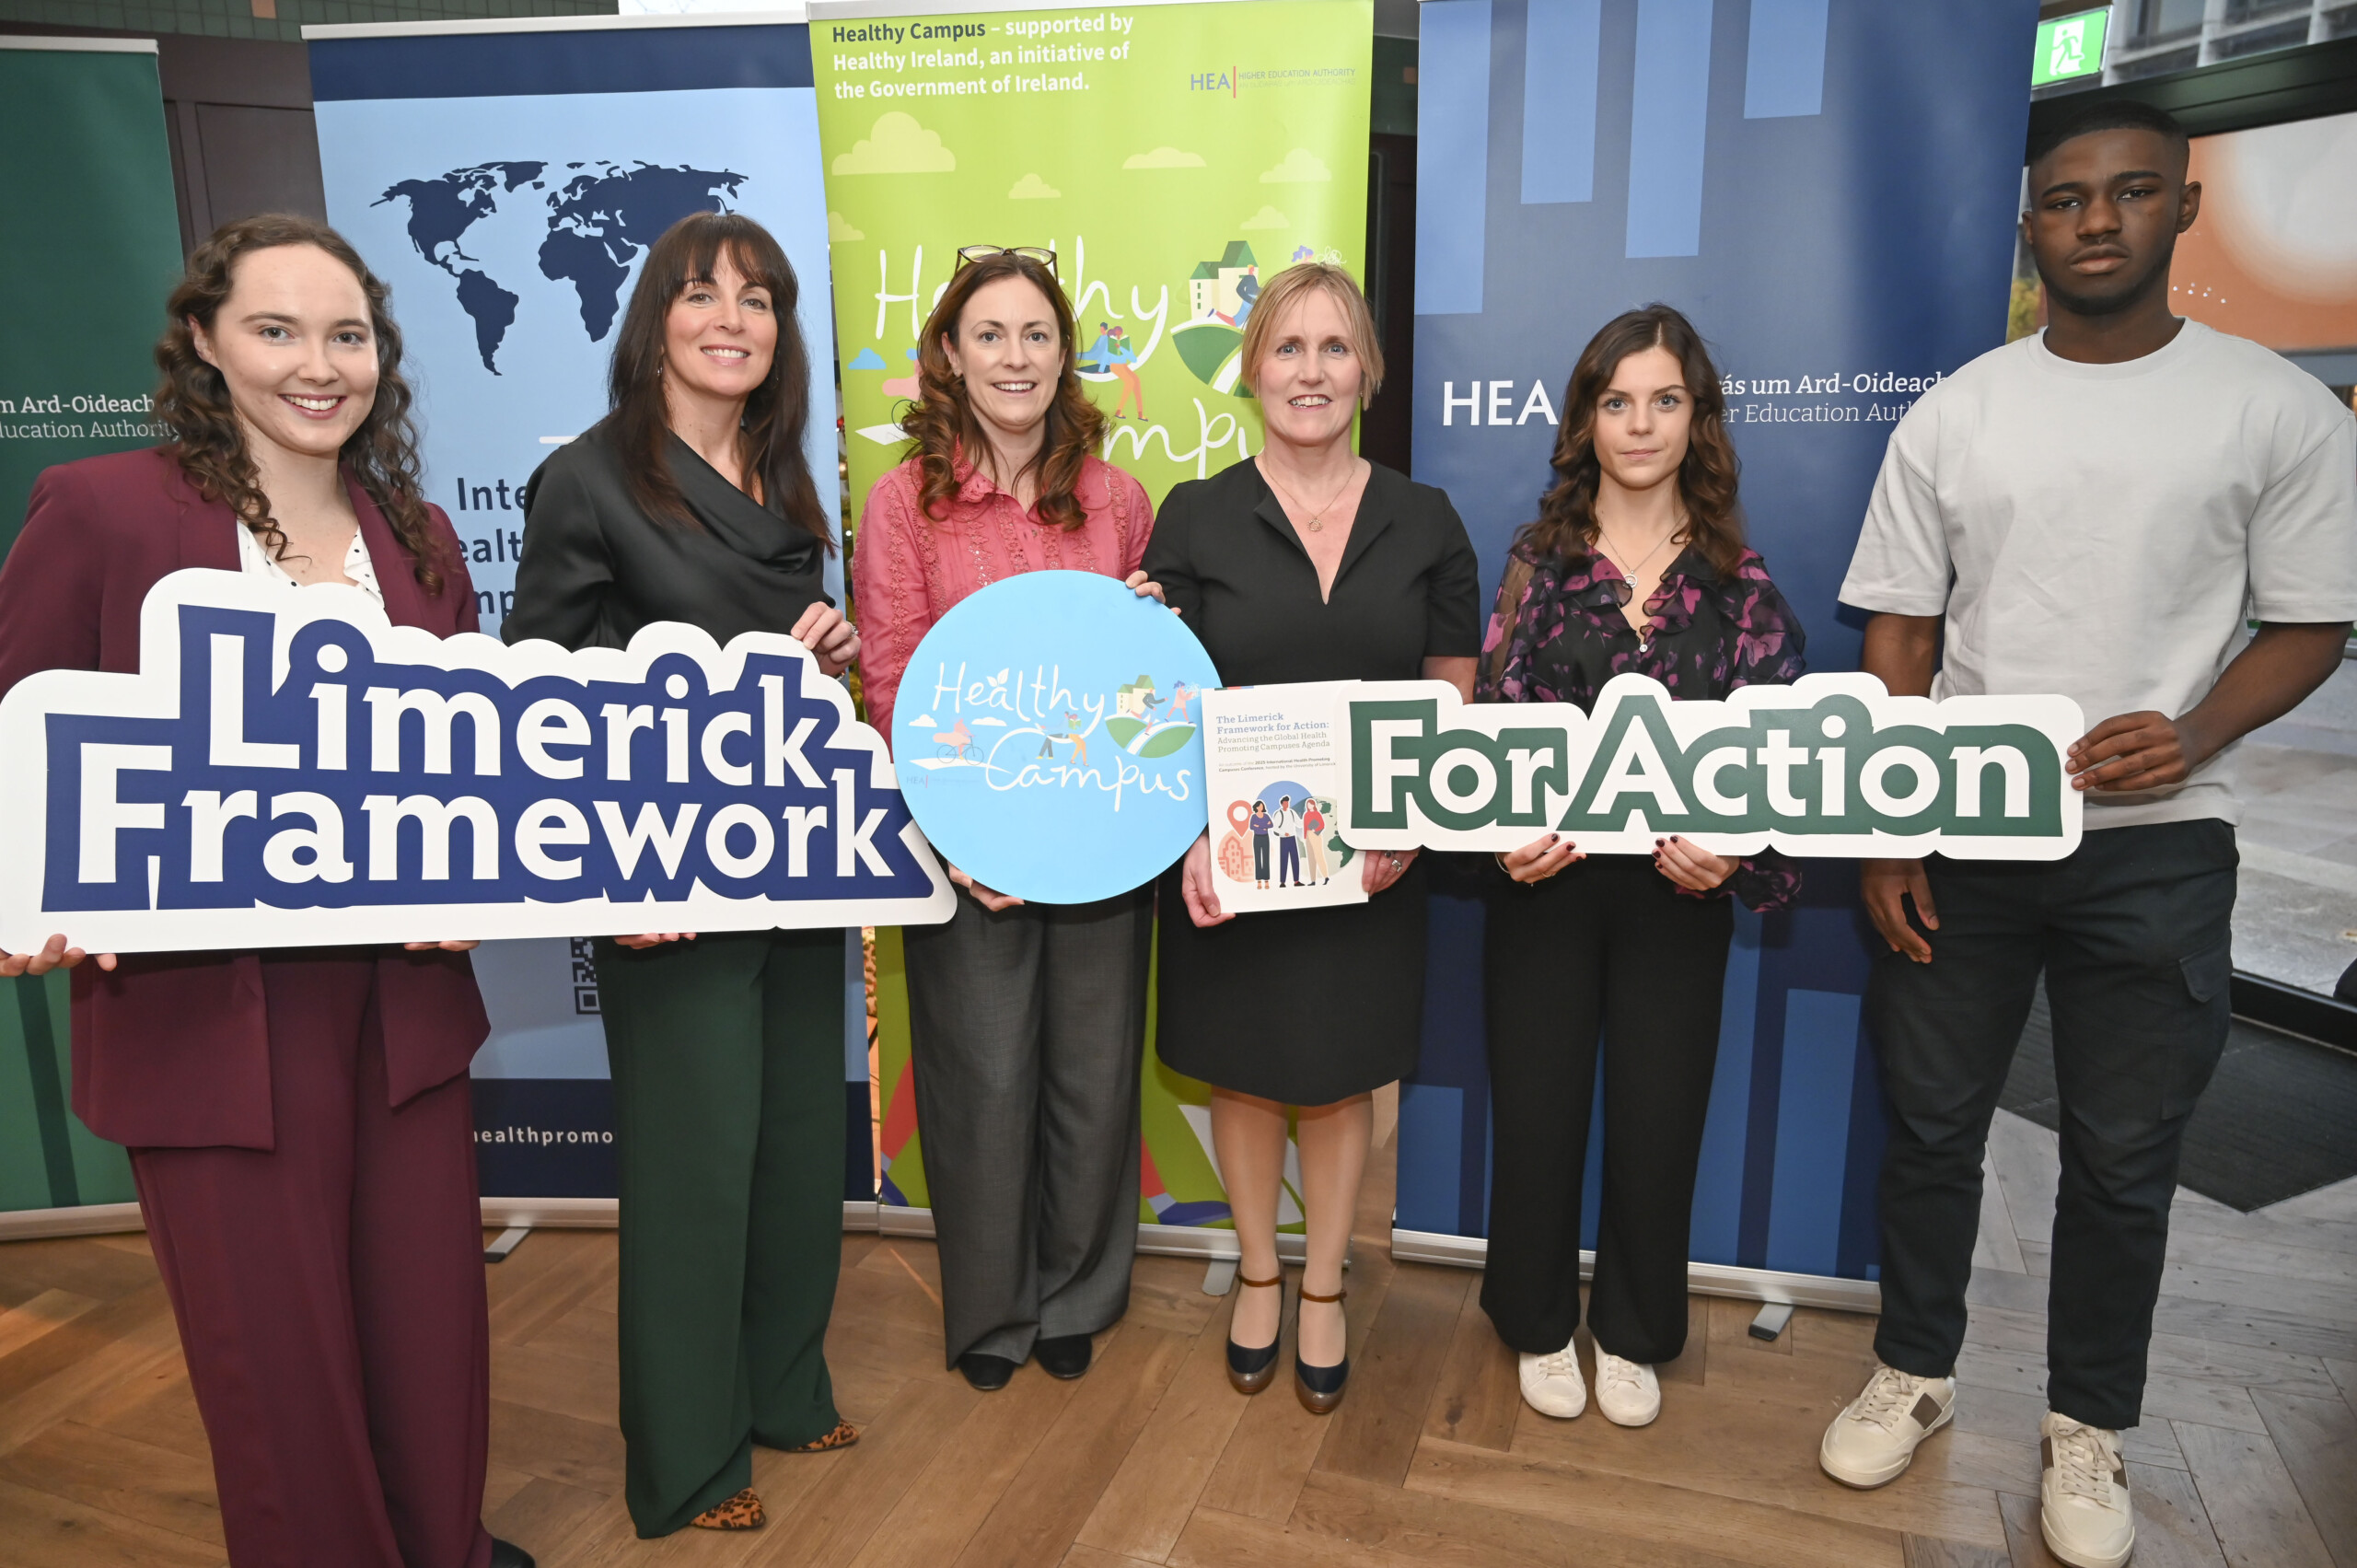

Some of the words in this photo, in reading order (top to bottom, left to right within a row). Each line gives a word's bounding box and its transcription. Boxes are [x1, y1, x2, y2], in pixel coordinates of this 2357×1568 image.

[832, 24, 905, 44] Healthy
[910, 22, 986, 42] Campus
[1004, 13, 1105, 39] supported
[1110, 13, 1134, 35] by
[833, 51, 906, 73] Healthy
[911, 48, 985, 69] Ireland,
[990, 48, 1013, 65] an
[1017, 43, 1105, 64] initiative
[1109, 41, 1131, 61] of
[834, 81, 865, 99] the
[869, 76, 987, 98] Government
[991, 75, 1012, 94] of
[1016, 72, 1090, 93] Ireland.
[1190, 73, 1231, 91] HEA
[1238, 71, 1266, 80] HIGHER
[1268, 69, 1311, 79] EDUCATION
[1313, 68, 1356, 77] AUTHORITY
[1443, 378, 1560, 426] HEA
[1751, 378, 1791, 395] um
[1745, 403, 1860, 423] Education
[209, 633, 827, 789] Limerick
[932, 661, 1105, 744] Healthy
[1215, 715, 1236, 725] The
[1237, 713, 1284, 724] Limerick
[1217, 724, 1274, 735] Framework
[1276, 723, 1291, 731] for
[1293, 721, 1329, 730] Action:
[1217, 736, 1260, 745] Advancing
[1274, 733, 1299, 741] Global
[1300, 731, 1327, 739] Health
[1218, 744, 1260, 753] Promoting
[1260, 742, 1300, 751] Campuses
[1301, 739, 1330, 749] Agenda
[985, 726, 1191, 813] Campus
[1370, 718, 1554, 815] For
[1586, 714, 2030, 819] Action
[77, 767, 895, 884] Framework
